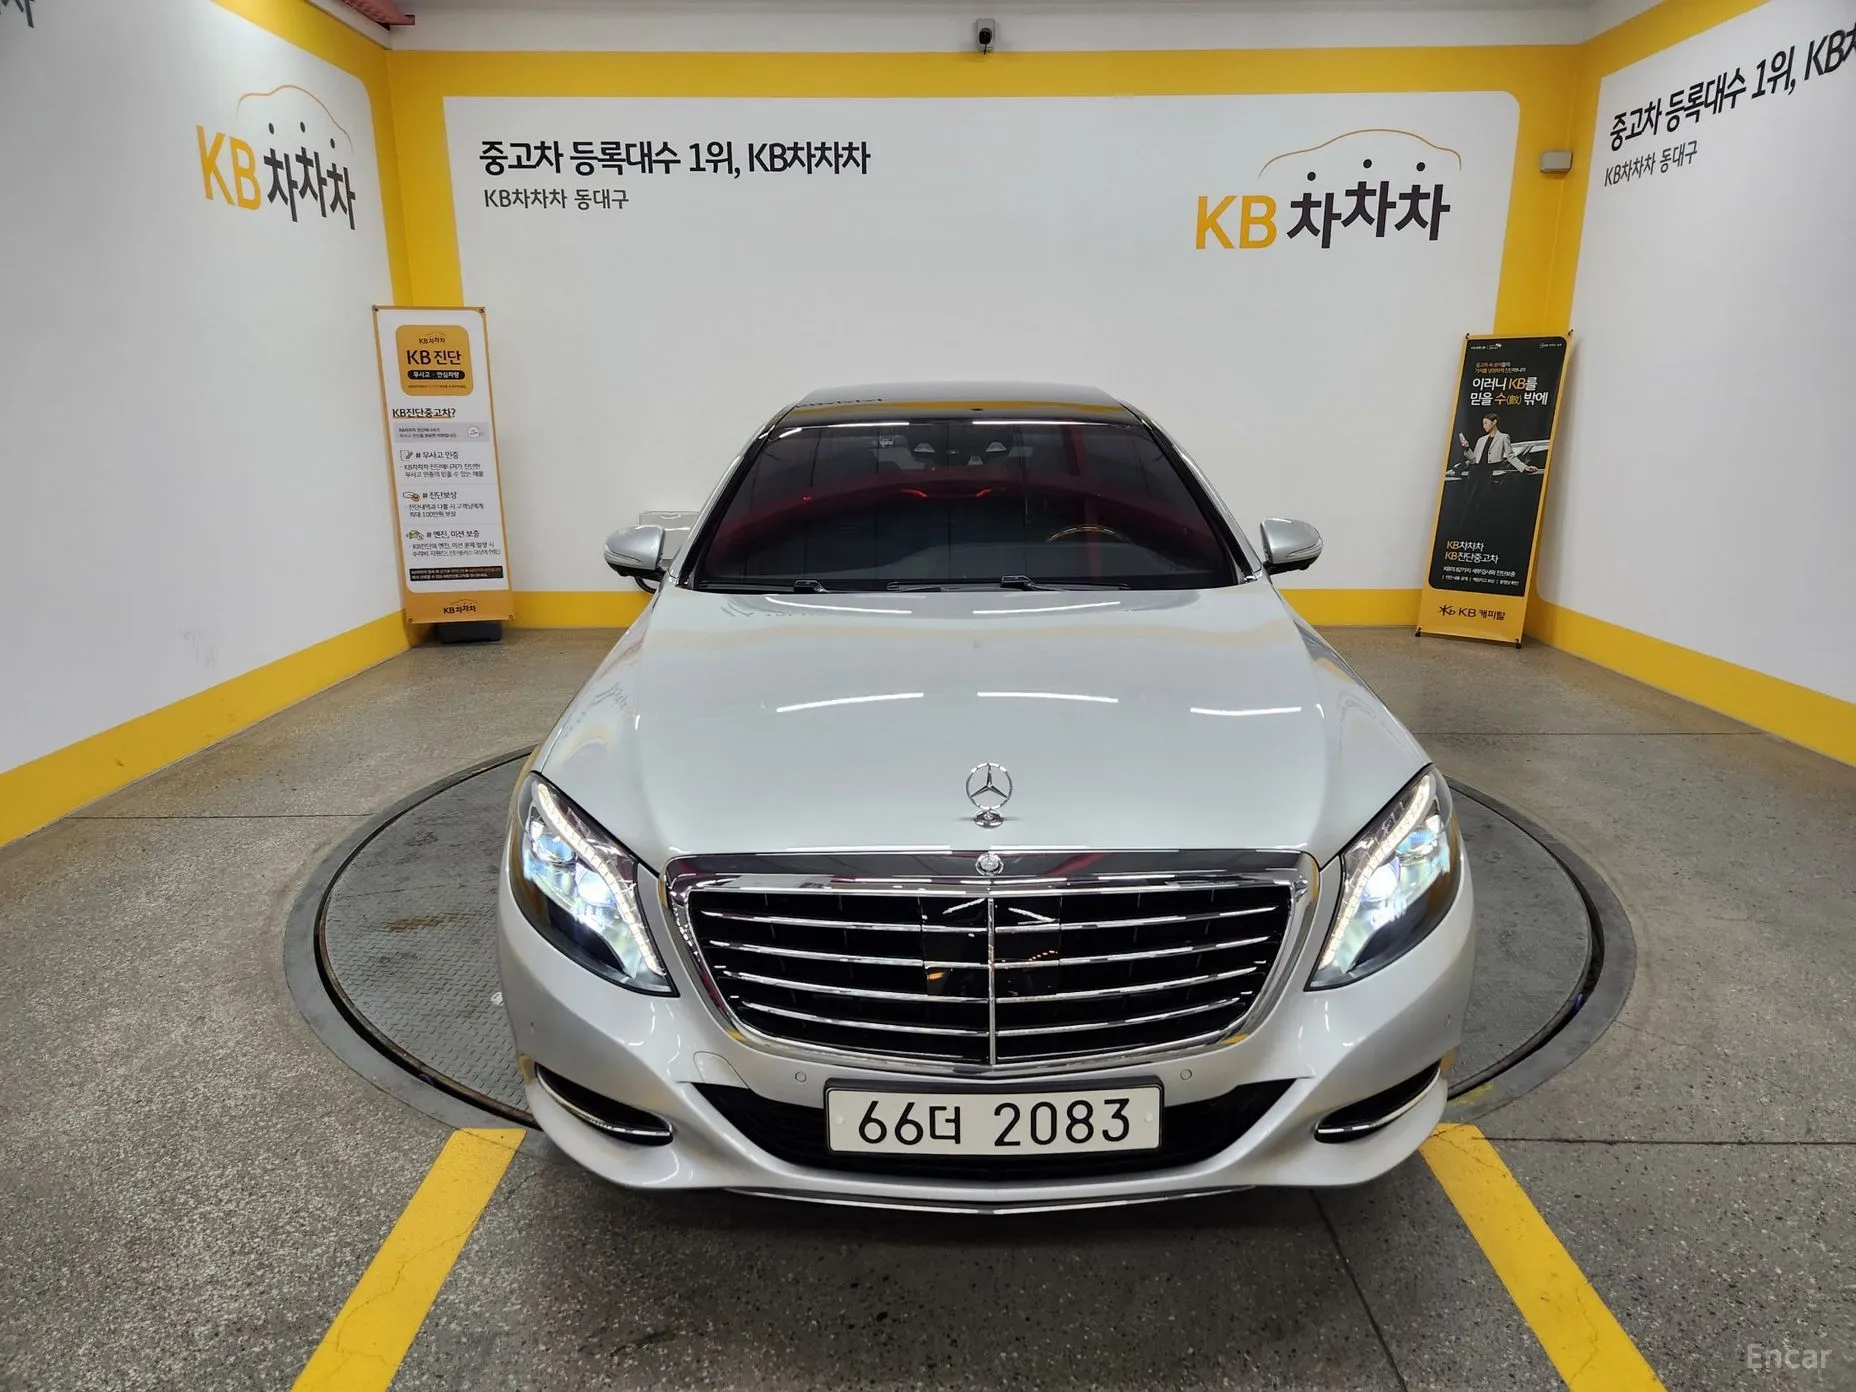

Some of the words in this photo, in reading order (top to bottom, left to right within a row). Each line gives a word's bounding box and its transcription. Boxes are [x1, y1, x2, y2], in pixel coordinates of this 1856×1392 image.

[1609, 97, 1663, 151] 중고차
[1664, 67, 1748, 133] 등록대수
[1751, 45, 1796, 99] 1위,
[479, 140, 564, 176] 중고차
[569, 140, 681, 177] 등록대수
[689, 141, 741, 179] 1위,
[748, 140, 872, 175] KB차차차
[1604, 152, 1656, 187] KB차차차
[1659, 140, 1698, 174] 동대구
[484, 187, 567, 210] KB차차차
[574, 187, 630, 211] 동대구
[406, 349, 432, 365] KB
[434, 349, 462, 366] 진단
[1472, 377, 1507, 391] 이러니
[1508, 376, 1538, 392] KB를
[1470, 392, 1493, 406] 믿을
[1524, 392, 1549, 406] 밖에
[392, 408, 456, 419] KB진단중고차?
[422, 451, 443, 459] 무사고
[444, 451, 459, 459] 인증
[429, 491, 457, 500] 진단보상
[451, 530, 465, 538] 미션
[466, 530, 480, 538] 보증
[1446, 540, 1485, 552] KB차차차
[1445, 551, 1499, 565] KB진단중고차
[1458, 607, 1477, 618] KB
[858, 1100, 961, 1145] 66더
[993, 1098, 1131, 1146] 2083
